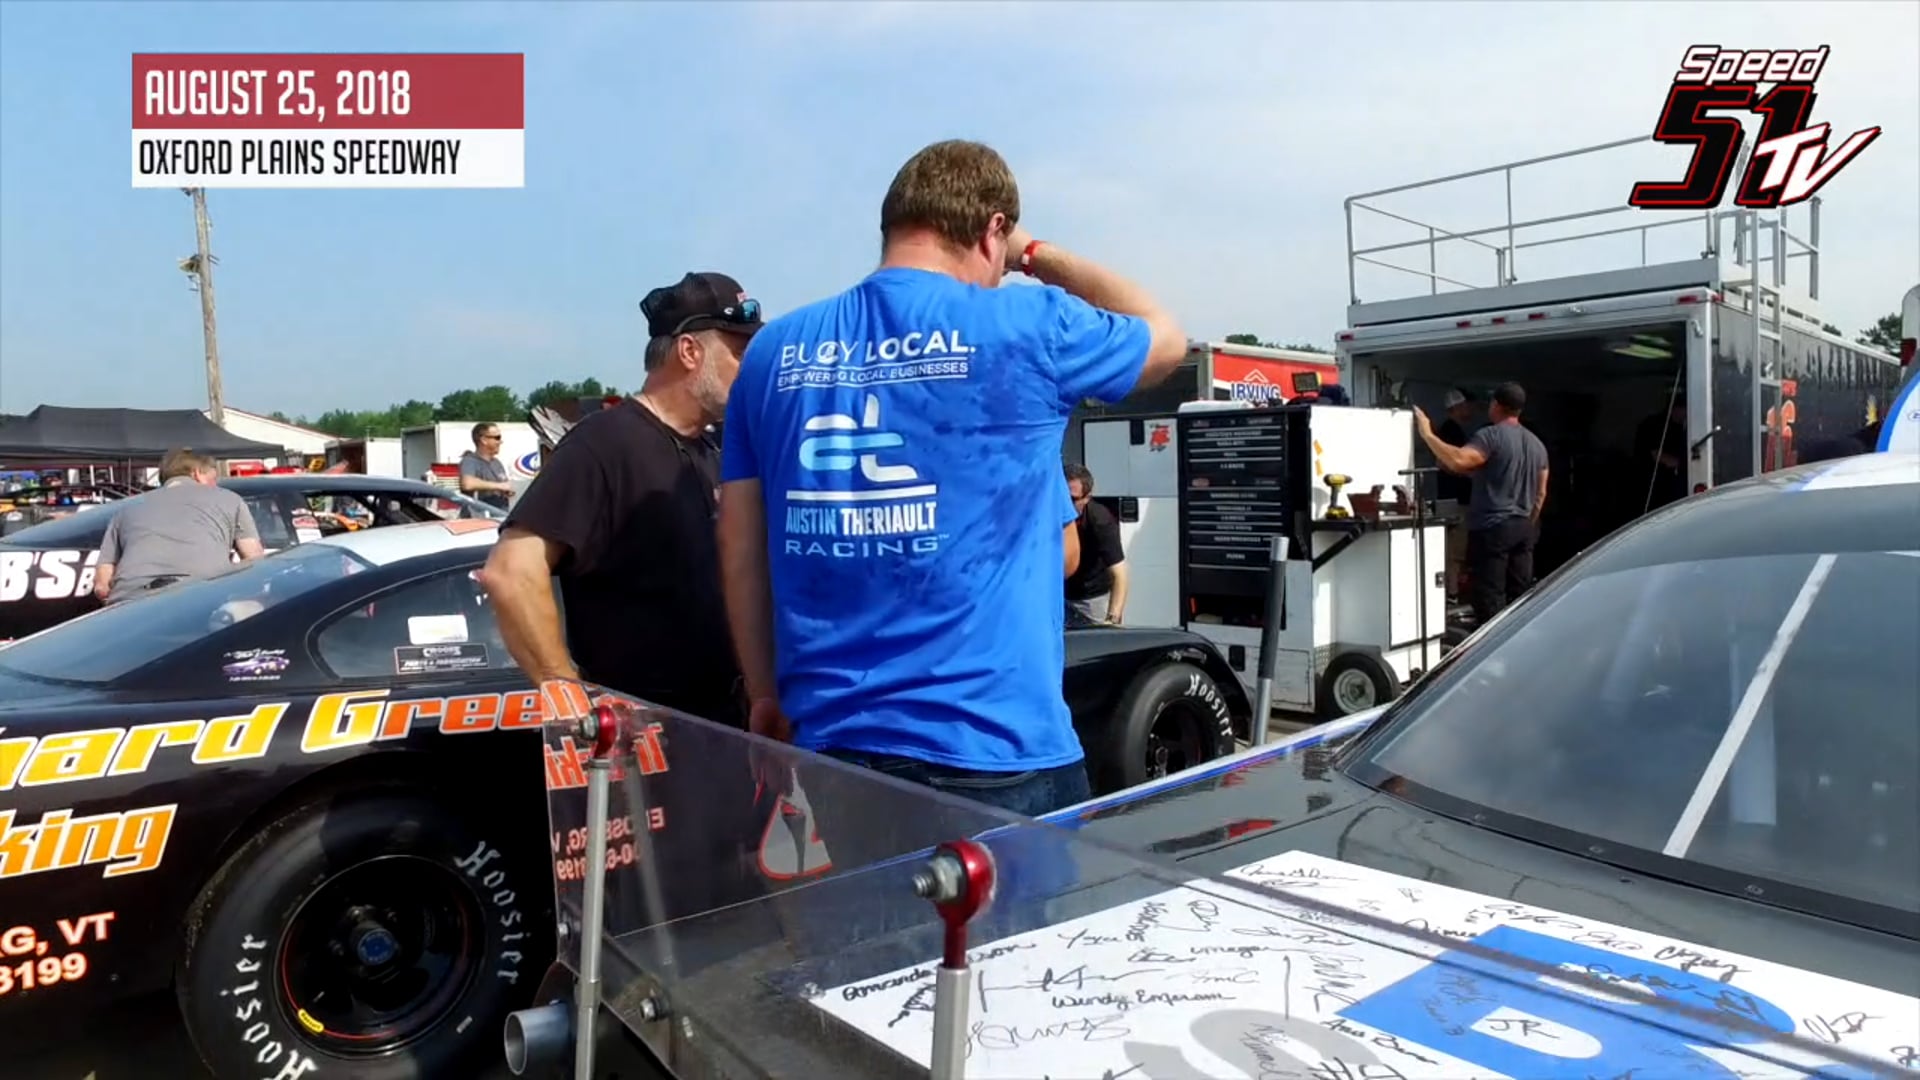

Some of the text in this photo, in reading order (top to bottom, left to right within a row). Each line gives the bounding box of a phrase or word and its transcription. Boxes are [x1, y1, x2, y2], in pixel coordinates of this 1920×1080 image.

[864, 328, 977, 363] LOCAL.
[850, 369, 887, 384] LOCAL
[889, 360, 969, 379] BUSINESSES
[1230, 383, 1281, 401] IRVING
[785, 501, 937, 536] AUSTIN THERIAULT
[301, 688, 543, 753] Gree
[452, 840, 532, 985] Hoosier
[0, 911, 115, 958] G, VT
